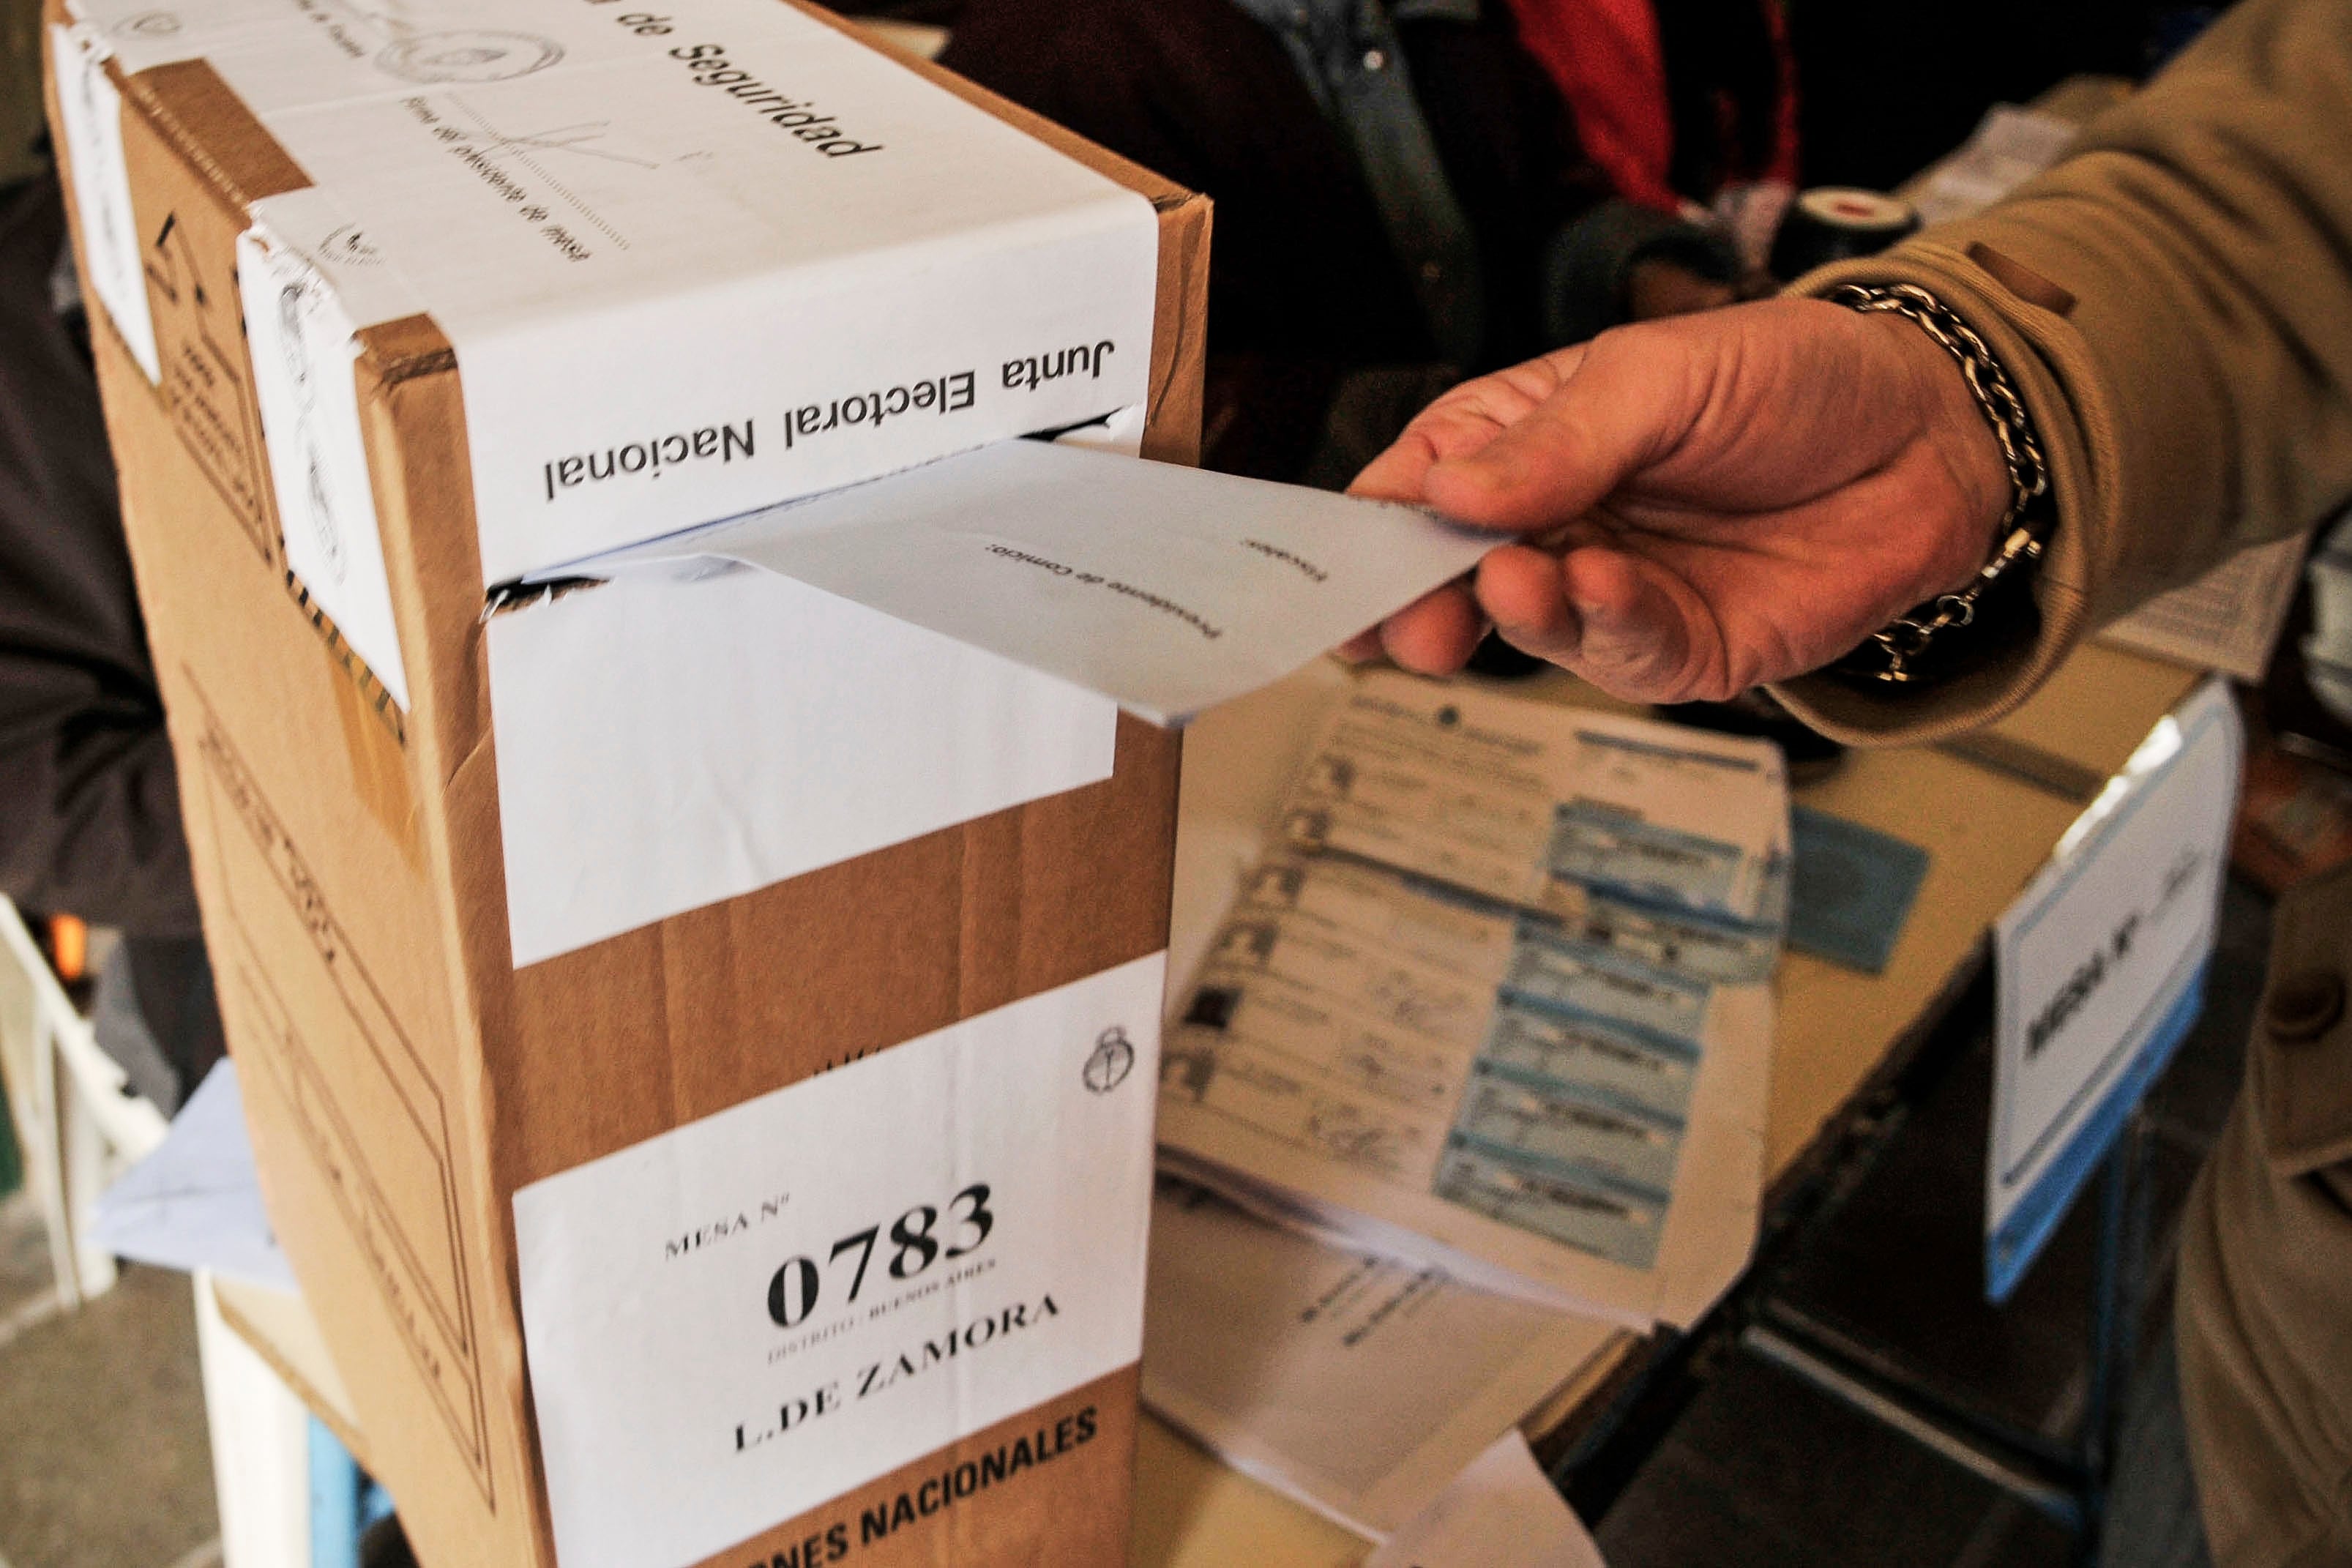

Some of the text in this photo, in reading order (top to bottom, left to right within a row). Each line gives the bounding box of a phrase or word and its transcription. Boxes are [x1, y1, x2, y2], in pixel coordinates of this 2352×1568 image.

[615, 12, 884, 158] de Seguridad
[542, 340, 1116, 502] Junta Electoral Nacional
[985, 543, 1073, 576] Comicio:
[1075, 572, 1104, 584] de
[665, 1212, 748, 1263] MESA
[766, 1183, 994, 1329] 0783
[856, 1291, 1059, 1398] ZAMORA
[860, 1404, 1098, 1548] NACIONALES
